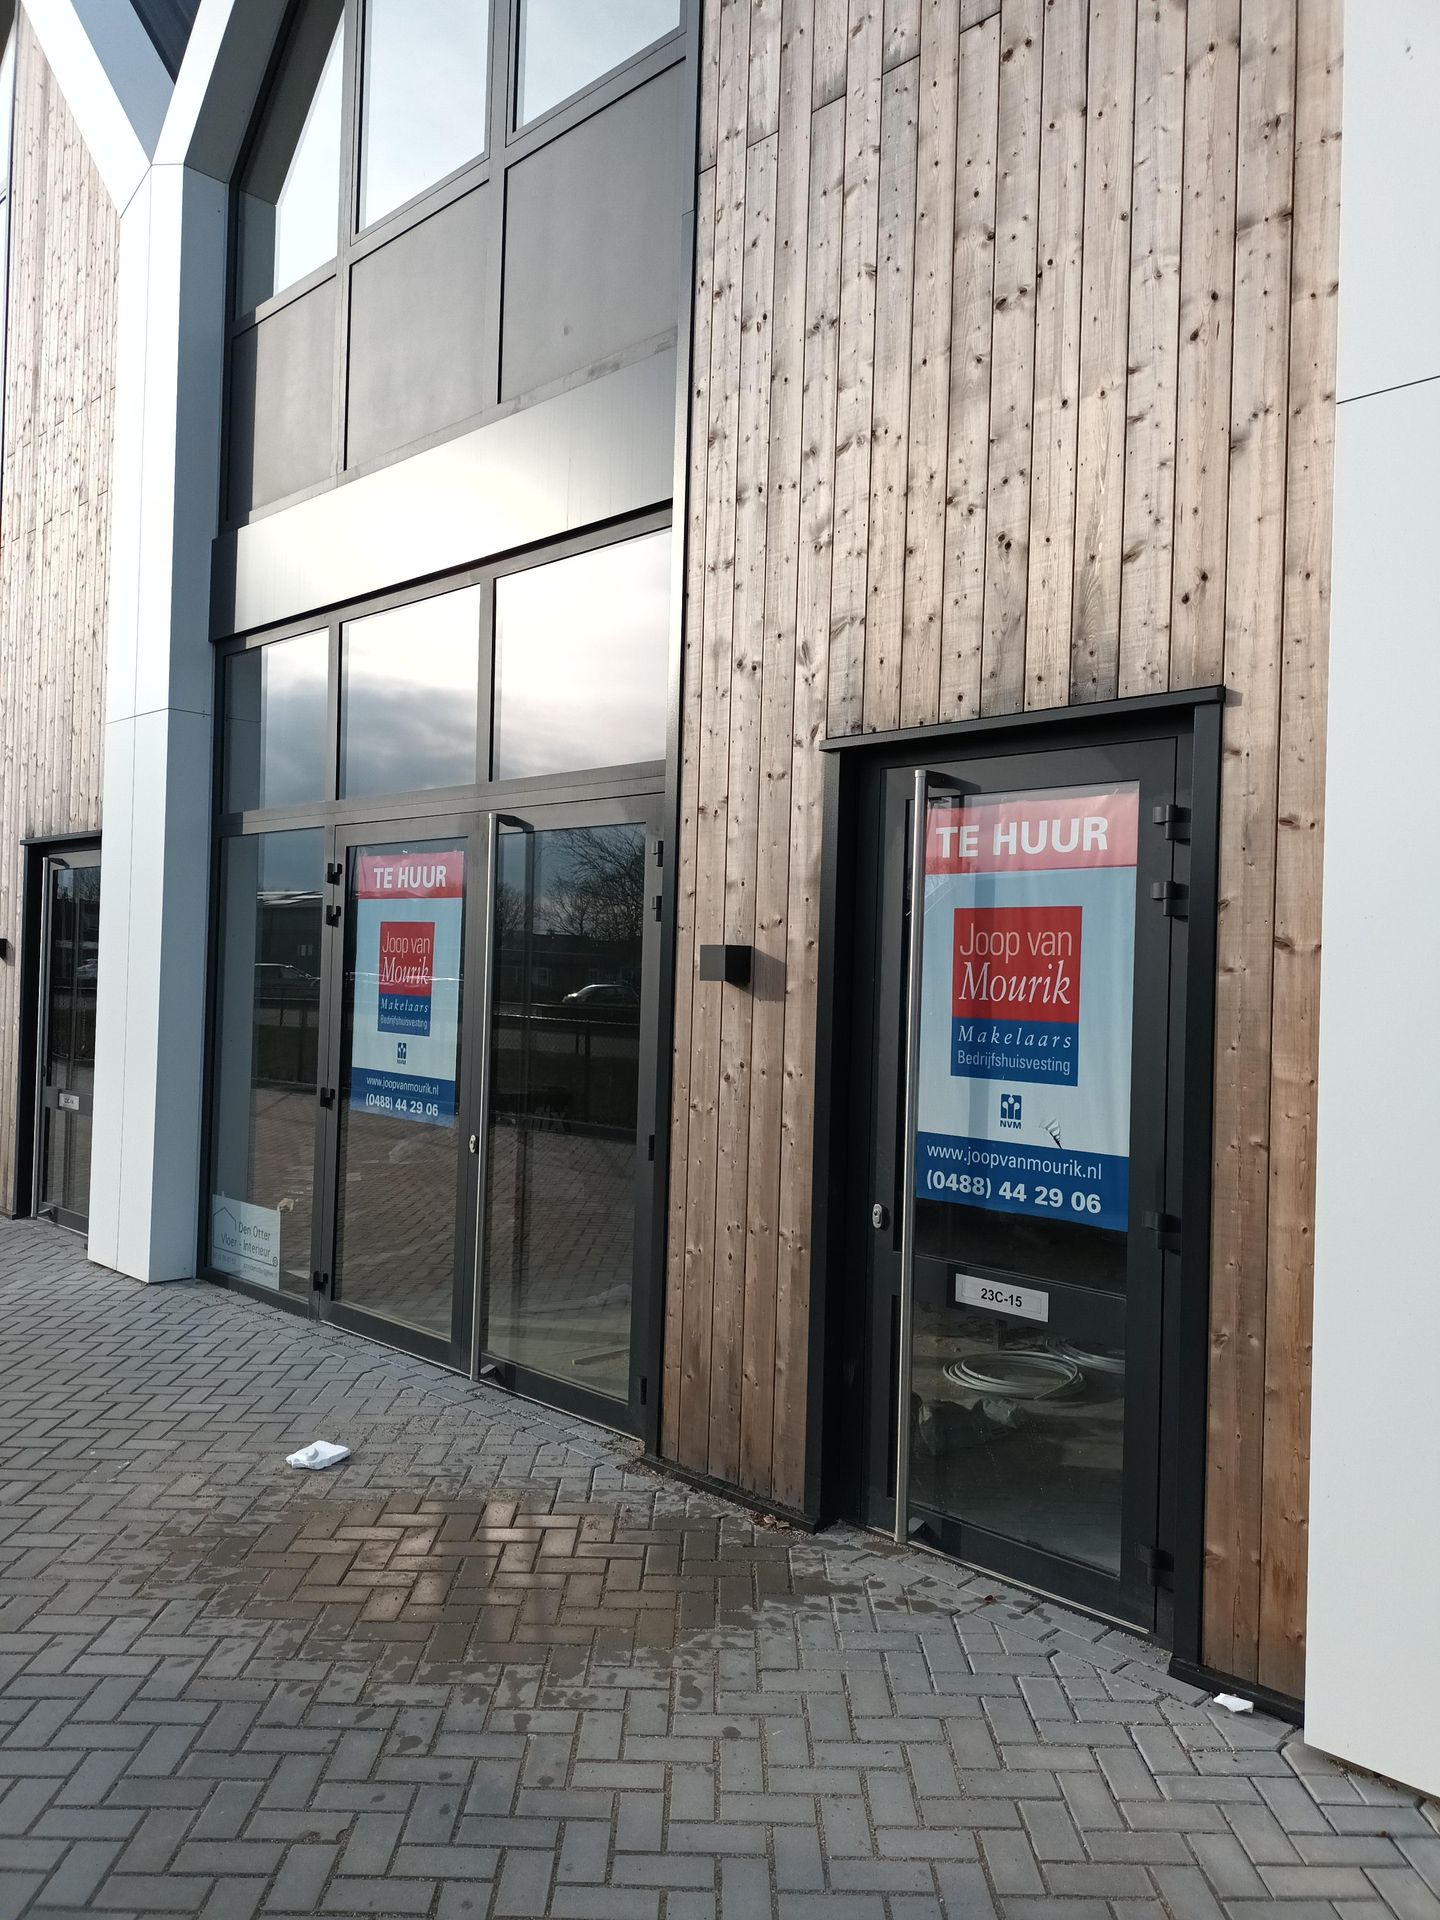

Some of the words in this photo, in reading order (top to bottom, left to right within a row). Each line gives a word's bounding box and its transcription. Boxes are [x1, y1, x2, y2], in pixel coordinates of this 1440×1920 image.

[935, 825, 979, 858] TE
[992, 816, 1108, 856] HUUR
[374, 868, 393, 889] TE
[398, 866, 447, 889] HUUR
[382, 931, 409, 958] Joop
[411, 938, 430, 954] van
[960, 922, 1020, 963] Joop
[1027, 930, 1072, 957] van
[381, 956, 430, 985] Mourik
[958, 959, 1071, 1005] Mourik
[381, 998, 428, 1012] Makelaars
[957, 1025, 1072, 1049] Makelaars
[957, 1049, 1071, 1076] Bedrijfshuisvesting
[366, 1076, 439, 1095] www.joopvanmourik.nl
[365, 1093, 393, 1110] (0488)
[395, 1099, 407, 1112] 44
[409, 1101, 423, 1114] 29
[425, 1103, 439, 1117] 06
[1000, 1120, 1022, 1129] NVM
[926, 1144, 1102, 1180] www.joopvanmourik.nl
[926, 1169, 992, 1199] (0488)
[998, 1181, 1027, 1202] 44
[1034, 1186, 1064, 1208] 29
[1071, 1191, 1102, 1214] 06
[238, 1222, 251, 1235] Den
[253, 1226, 270, 1240] Otter
[981, 1287, 1023, 1308] 23C-15
